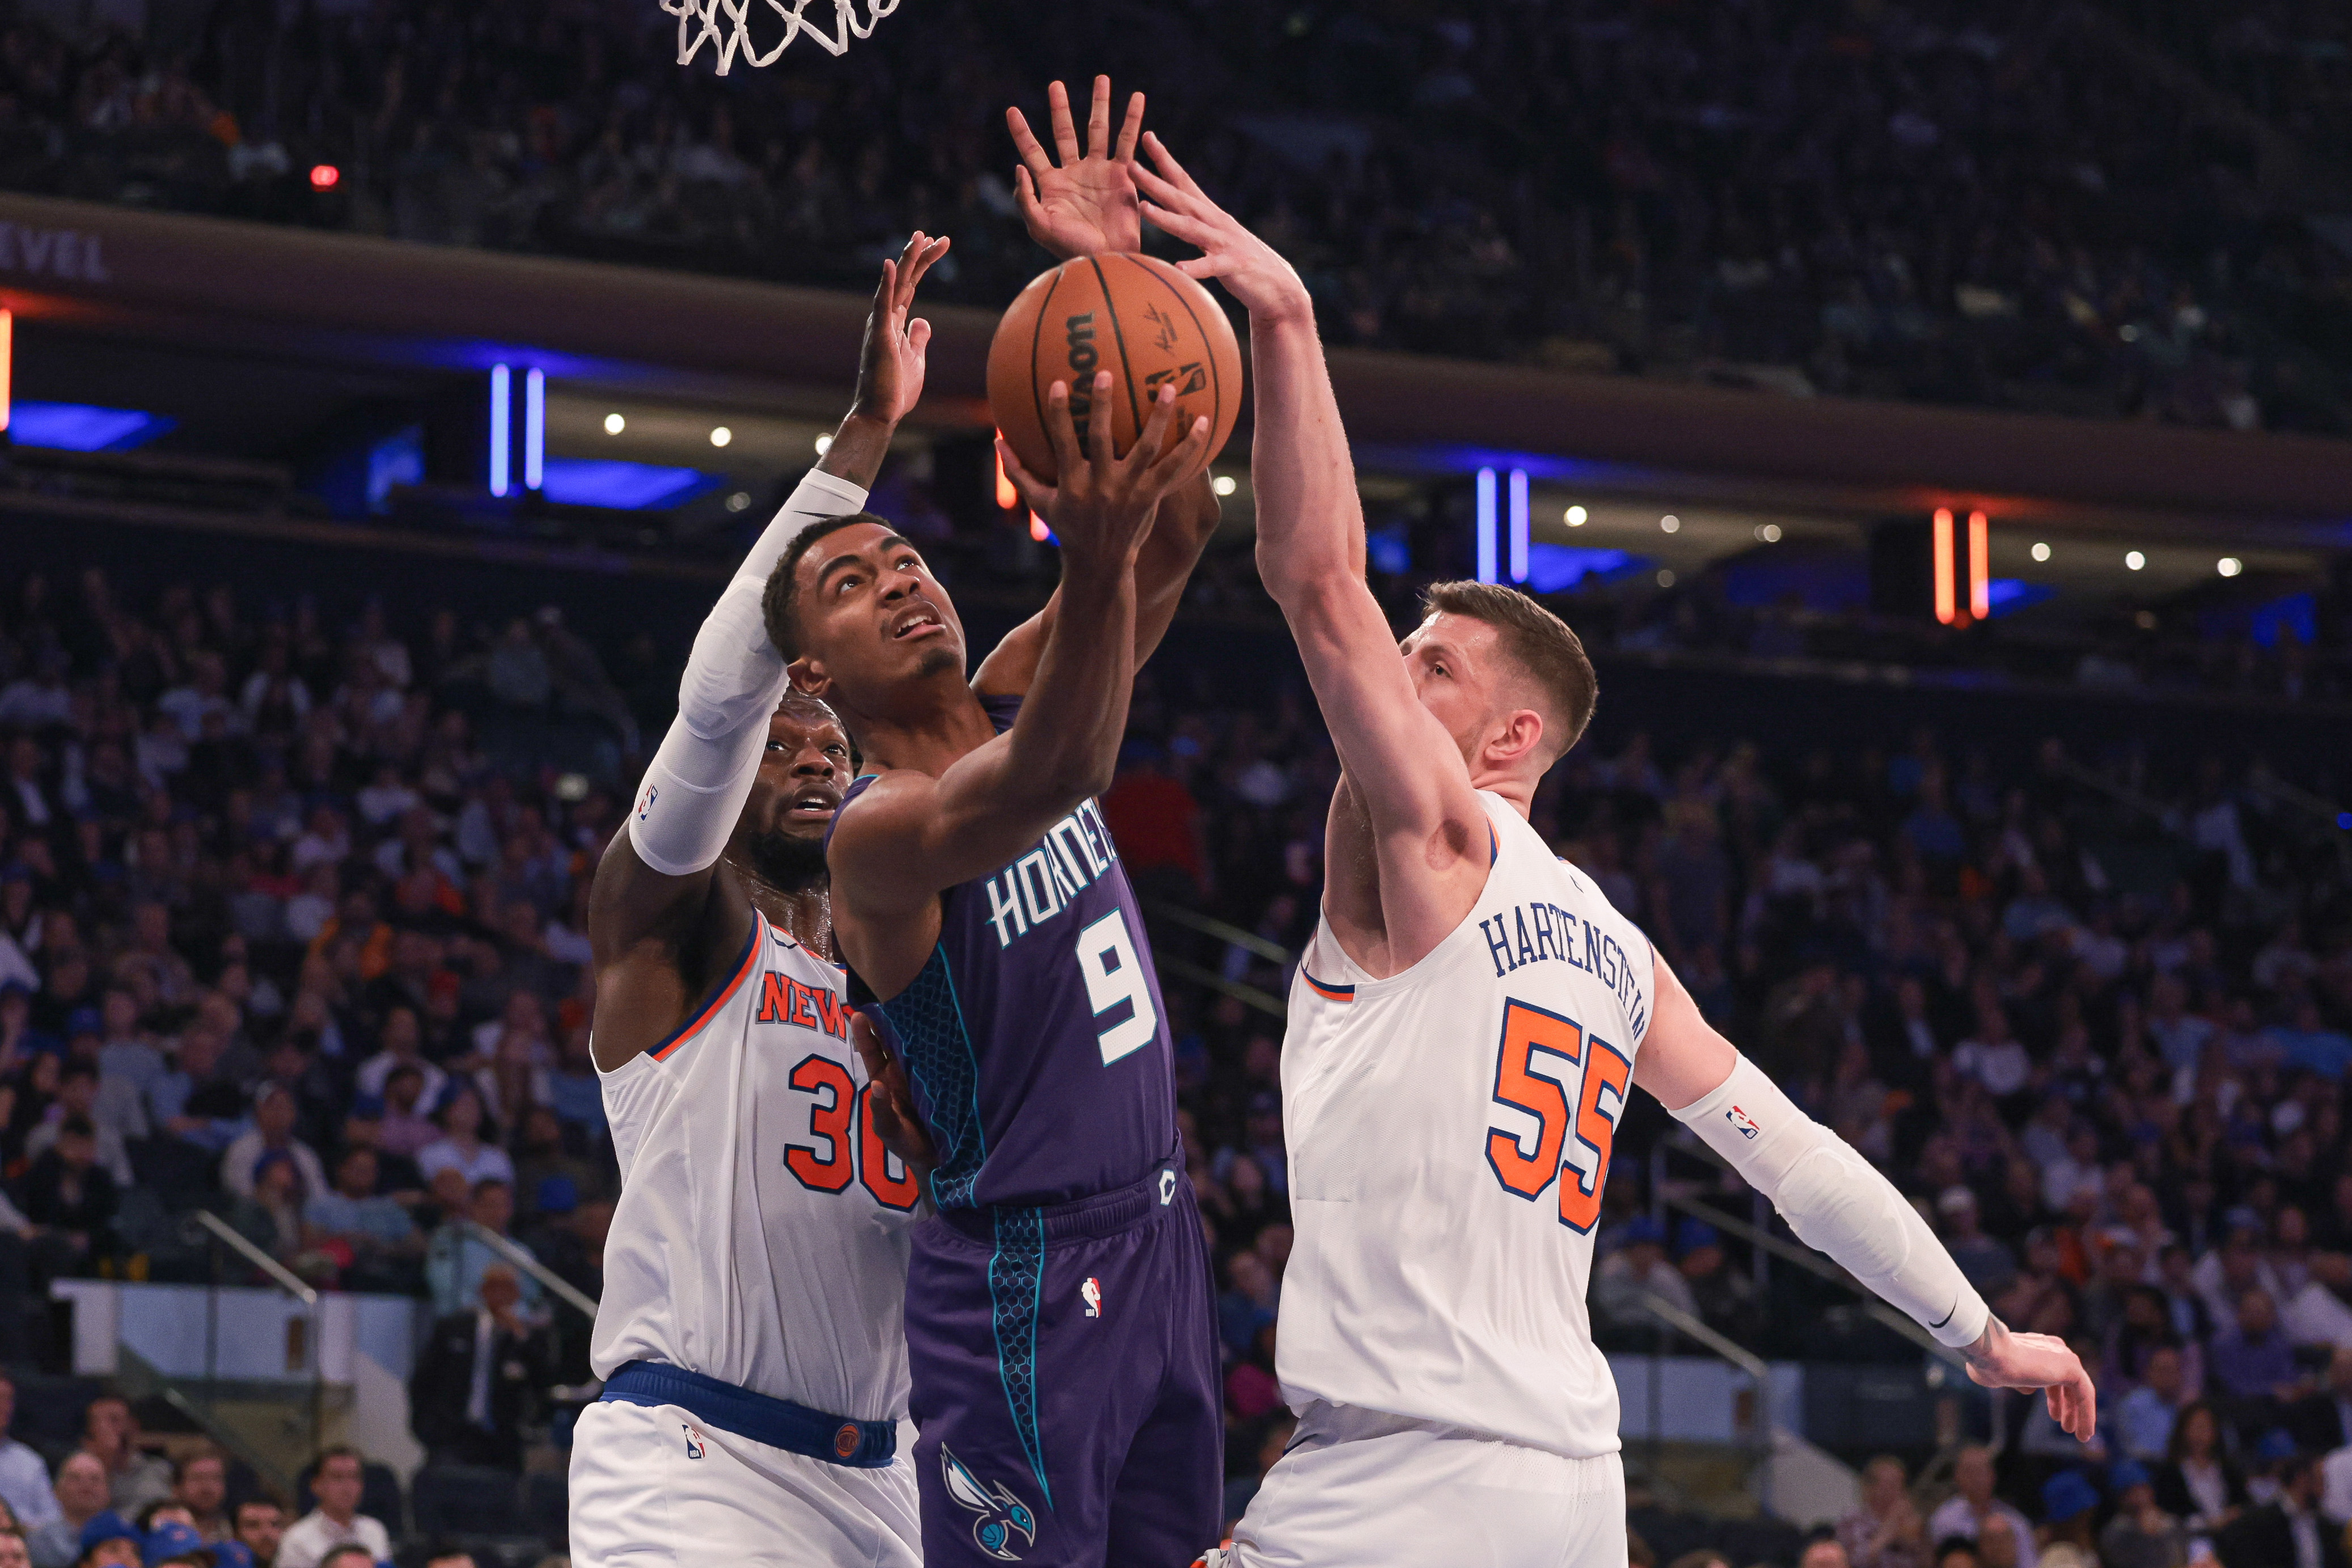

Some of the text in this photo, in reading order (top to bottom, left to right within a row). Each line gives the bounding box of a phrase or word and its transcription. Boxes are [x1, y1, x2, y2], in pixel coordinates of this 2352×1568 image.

[755, 970, 847, 1043] NEW
[1075, 907, 1158, 1068] 9
[1479, 902, 1645, 1041] HARTENSTEIN
[783, 1053, 920, 1214] 30
[1484, 996, 1632, 1236] 55
